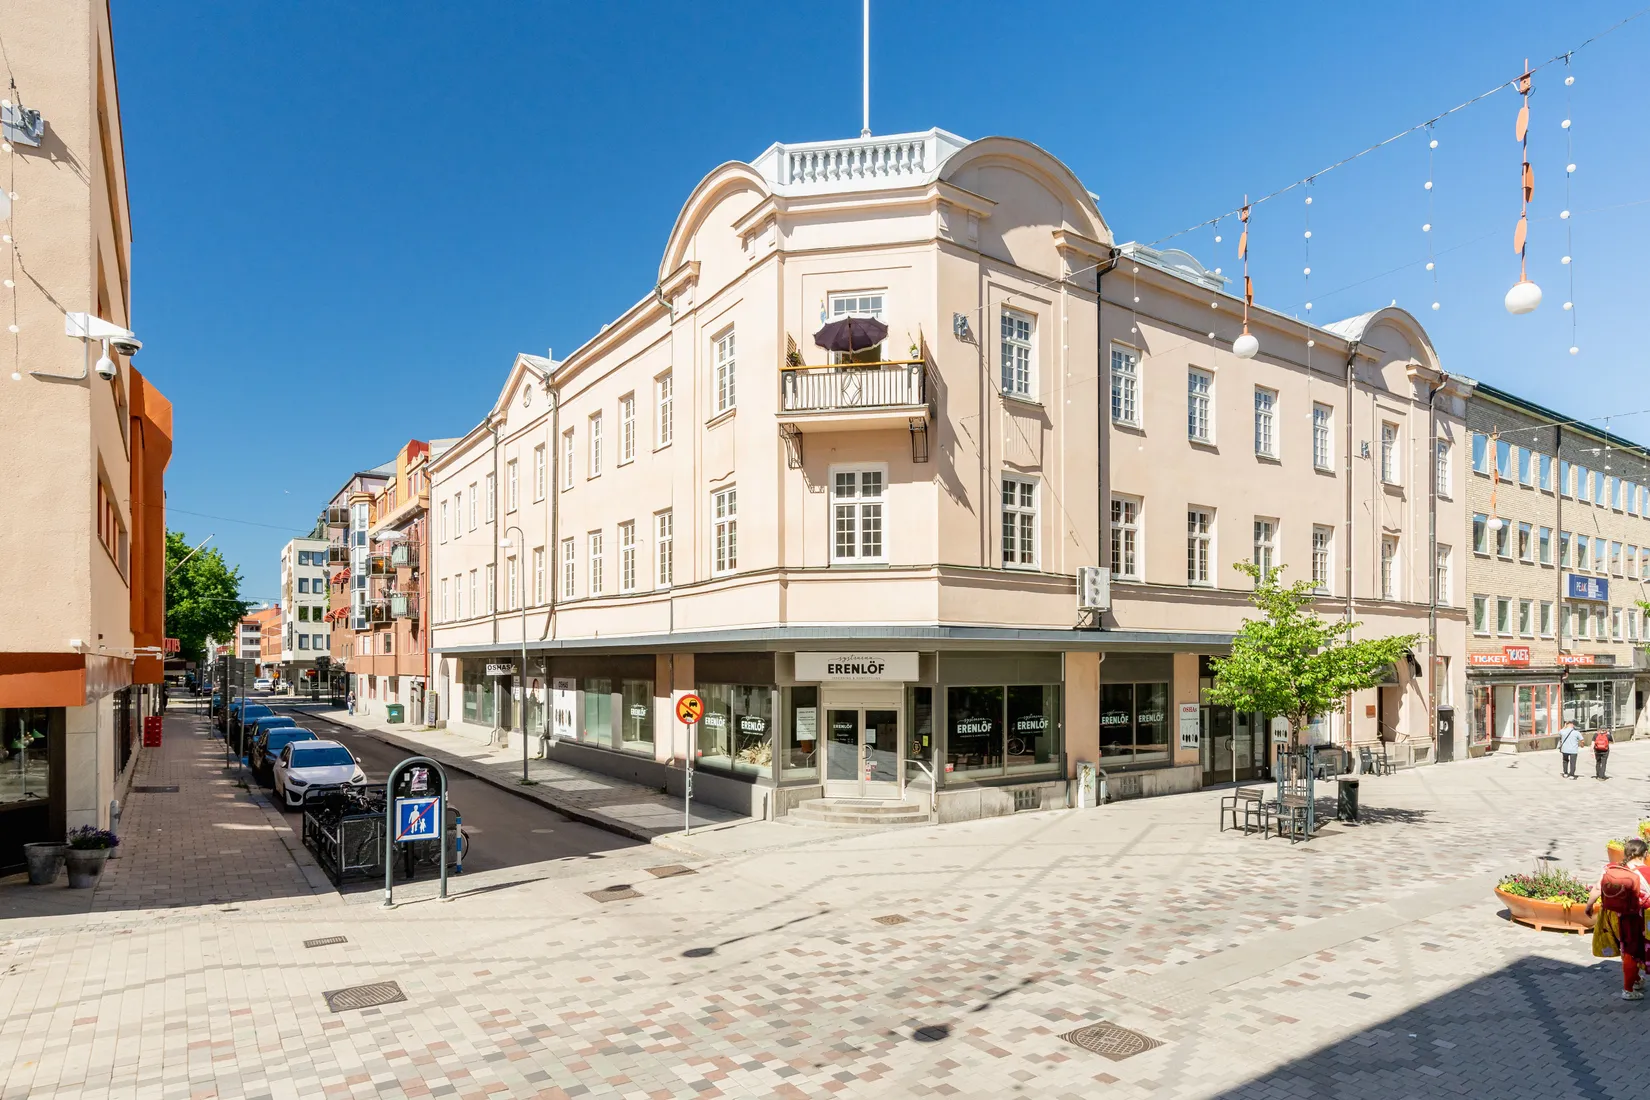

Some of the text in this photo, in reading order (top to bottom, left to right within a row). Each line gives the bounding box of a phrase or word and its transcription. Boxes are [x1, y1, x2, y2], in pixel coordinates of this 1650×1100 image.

[827, 661, 885, 674] ERENLÖF
[704, 716, 726, 727] ERENLÖF
[1017, 718, 1049, 730] ERENLÖF
[1101, 714, 1129, 725] ERENLÖF
[1138, 713, 1164, 723] ERENLÖF
[741, 720, 765, 732] ERENLÖF
[957, 720, 992, 734] ERENLÖF
